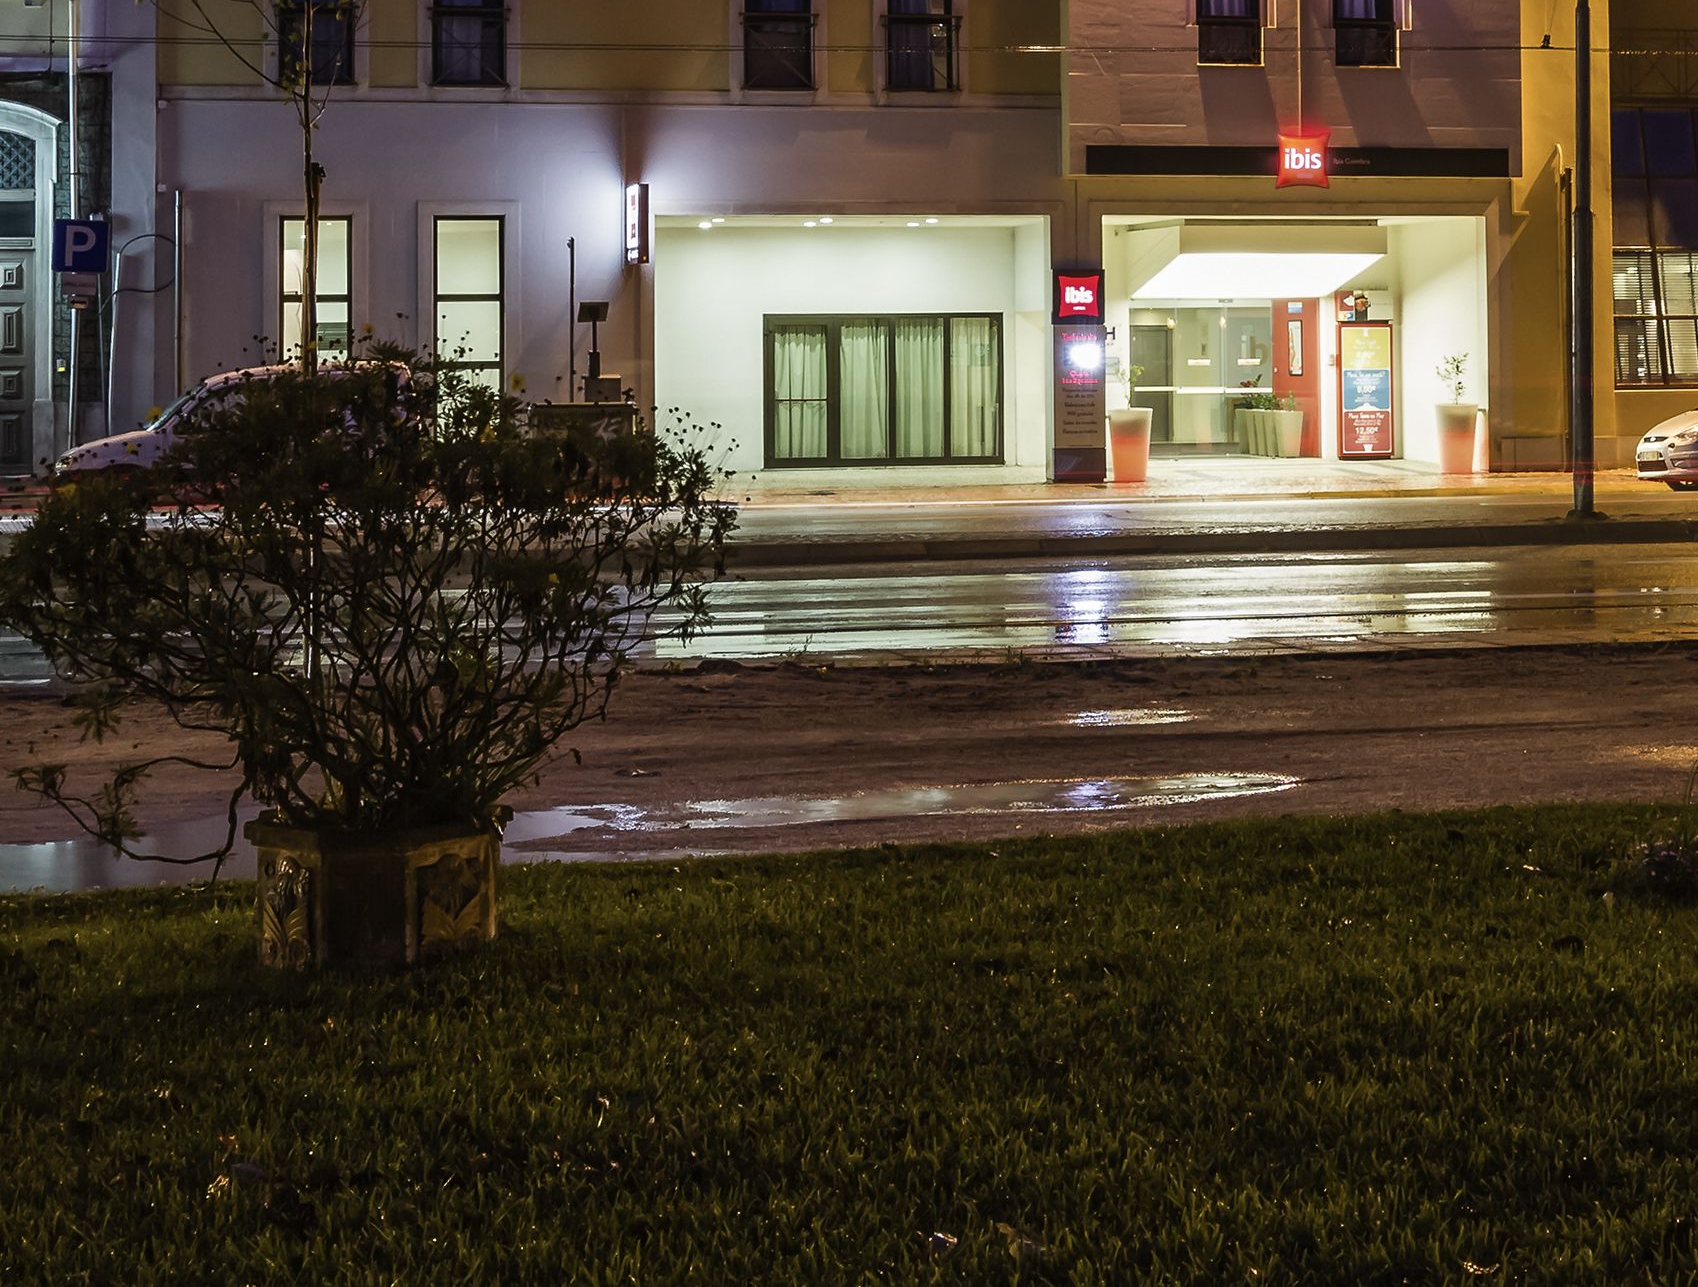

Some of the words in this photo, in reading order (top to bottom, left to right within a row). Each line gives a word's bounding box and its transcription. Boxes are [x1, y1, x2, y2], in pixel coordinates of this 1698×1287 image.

[1284, 147, 1322, 170] ibis
[65, 225, 97, 267] P
[1064, 285, 1094, 304] ibis
